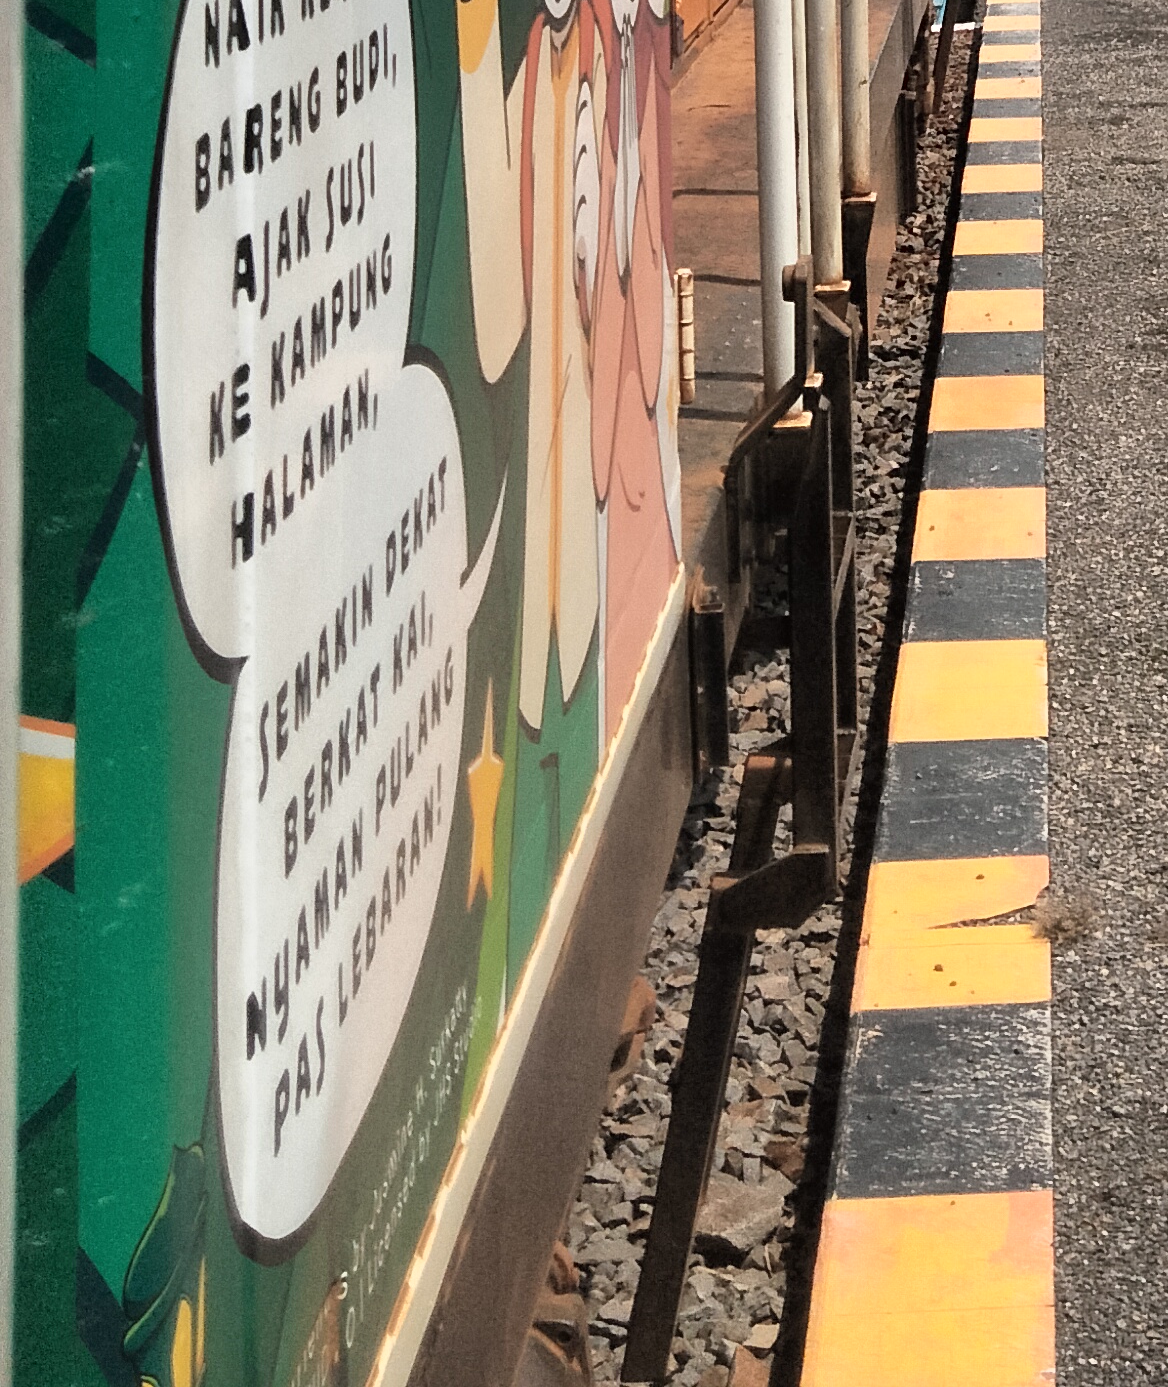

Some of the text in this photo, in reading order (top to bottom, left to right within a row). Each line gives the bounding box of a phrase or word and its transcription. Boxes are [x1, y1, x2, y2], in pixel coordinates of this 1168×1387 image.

[196, 24, 396, 211] BARENG BUDI,
[233, 140, 376, 318] AJAK SUSI
[209, 233, 392, 465] KE KAMPUNG
[231, 368, 379, 569] HALAMAN,
[259, 457, 449, 802] SEMAKIN DEKAT
[284, 592, 433, 879] BERKAT KAI,
[246, 644, 454, 1061] NYAMAN PULANG
[275, 763, 443, 1156] PAS LEBARAN!
